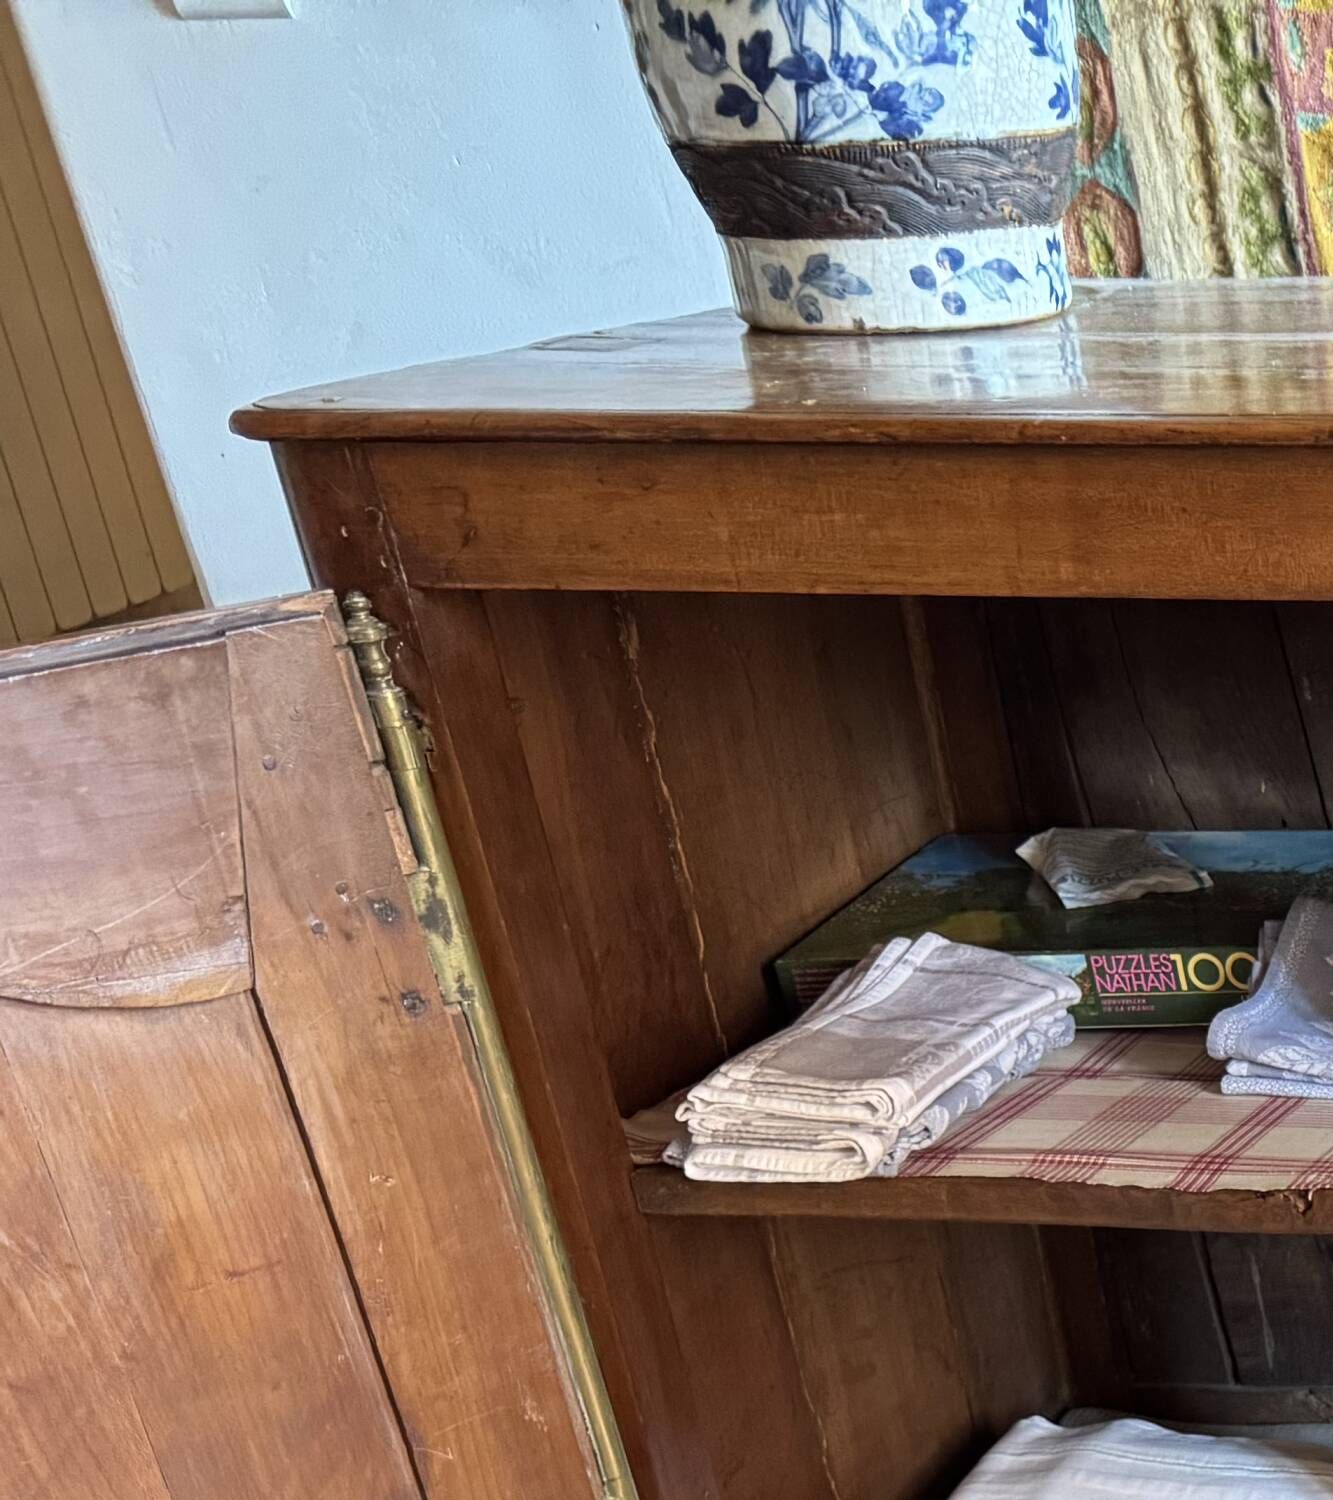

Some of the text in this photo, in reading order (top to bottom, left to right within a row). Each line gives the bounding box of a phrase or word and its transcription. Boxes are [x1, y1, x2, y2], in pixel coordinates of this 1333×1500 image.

[1090, 954, 1173, 975] PUZZLES
[1170, 952, 1256, 991] 100
[1095, 972, 1177, 993] NATHAN
